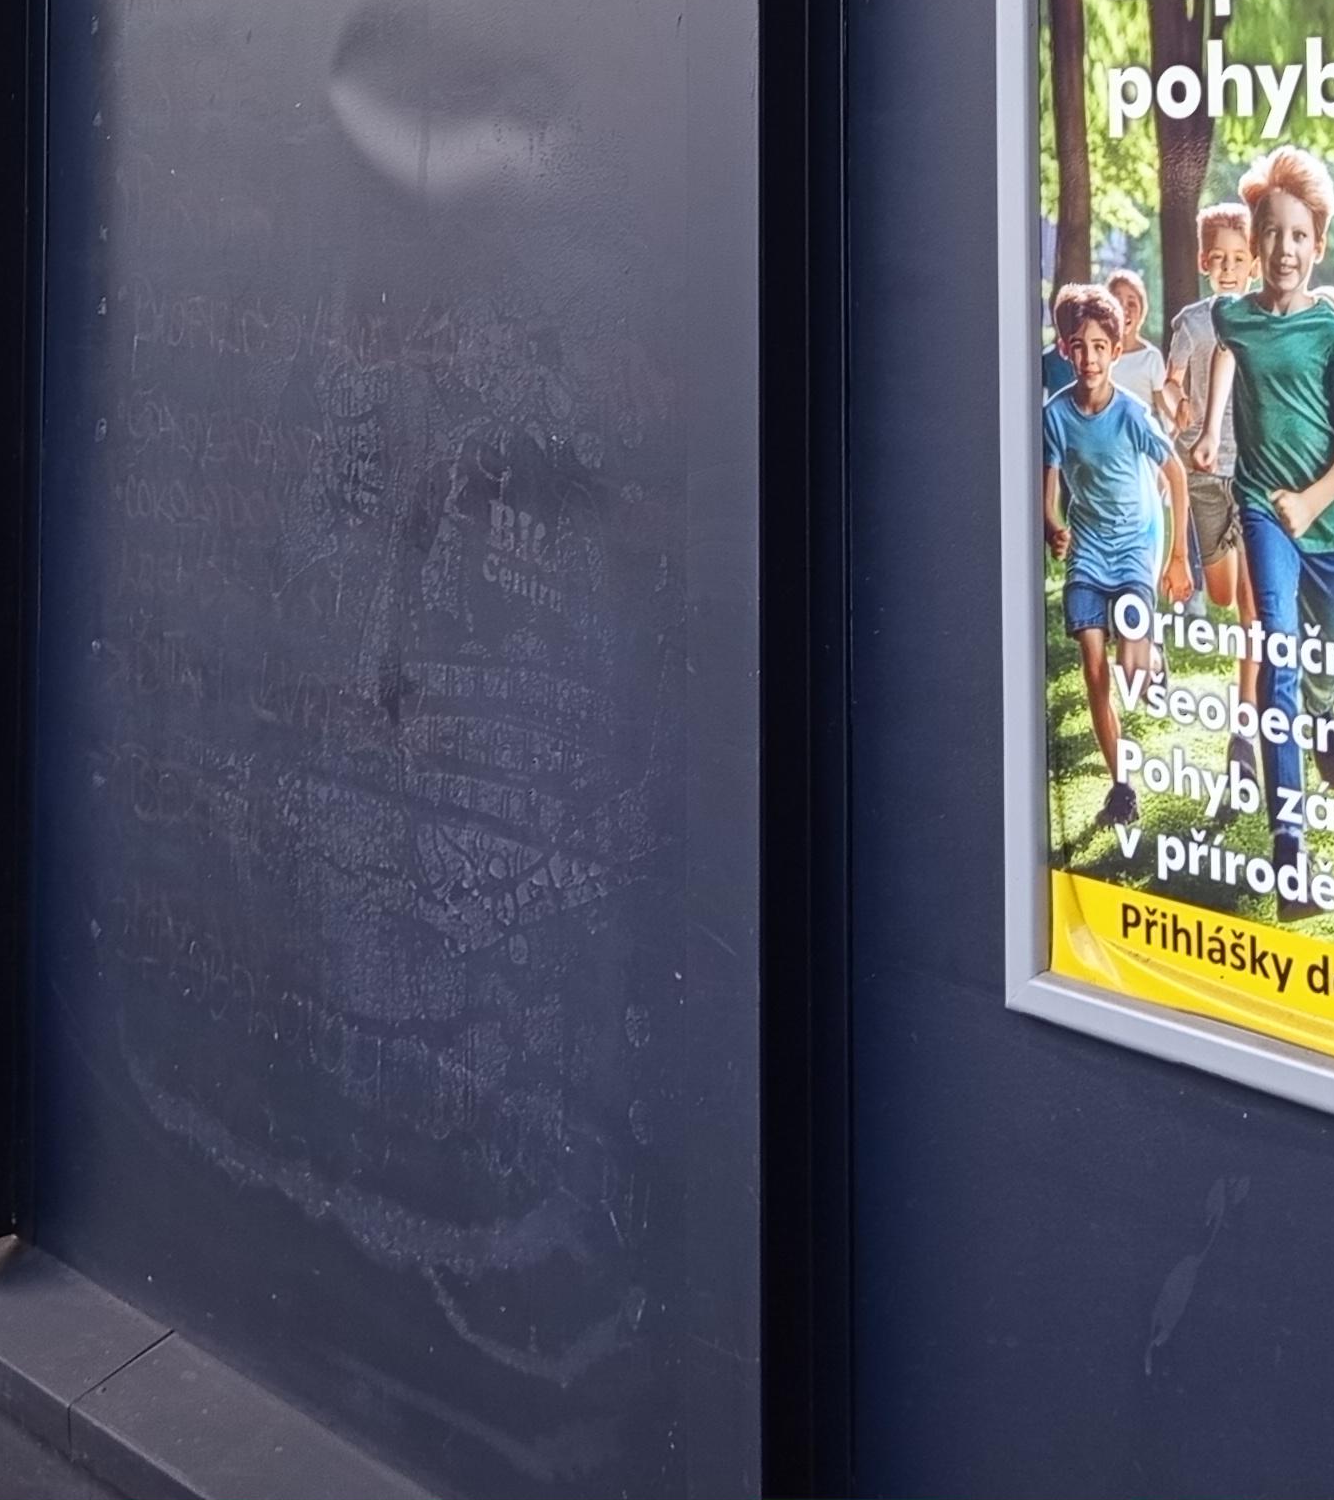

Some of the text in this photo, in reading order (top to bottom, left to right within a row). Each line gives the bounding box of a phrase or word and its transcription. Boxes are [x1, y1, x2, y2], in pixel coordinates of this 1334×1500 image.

[1116, 739, 1260, 818] Pohyb
[1116, 823, 1141, 858] v
[1121, 903, 1293, 991] Přihlášky
